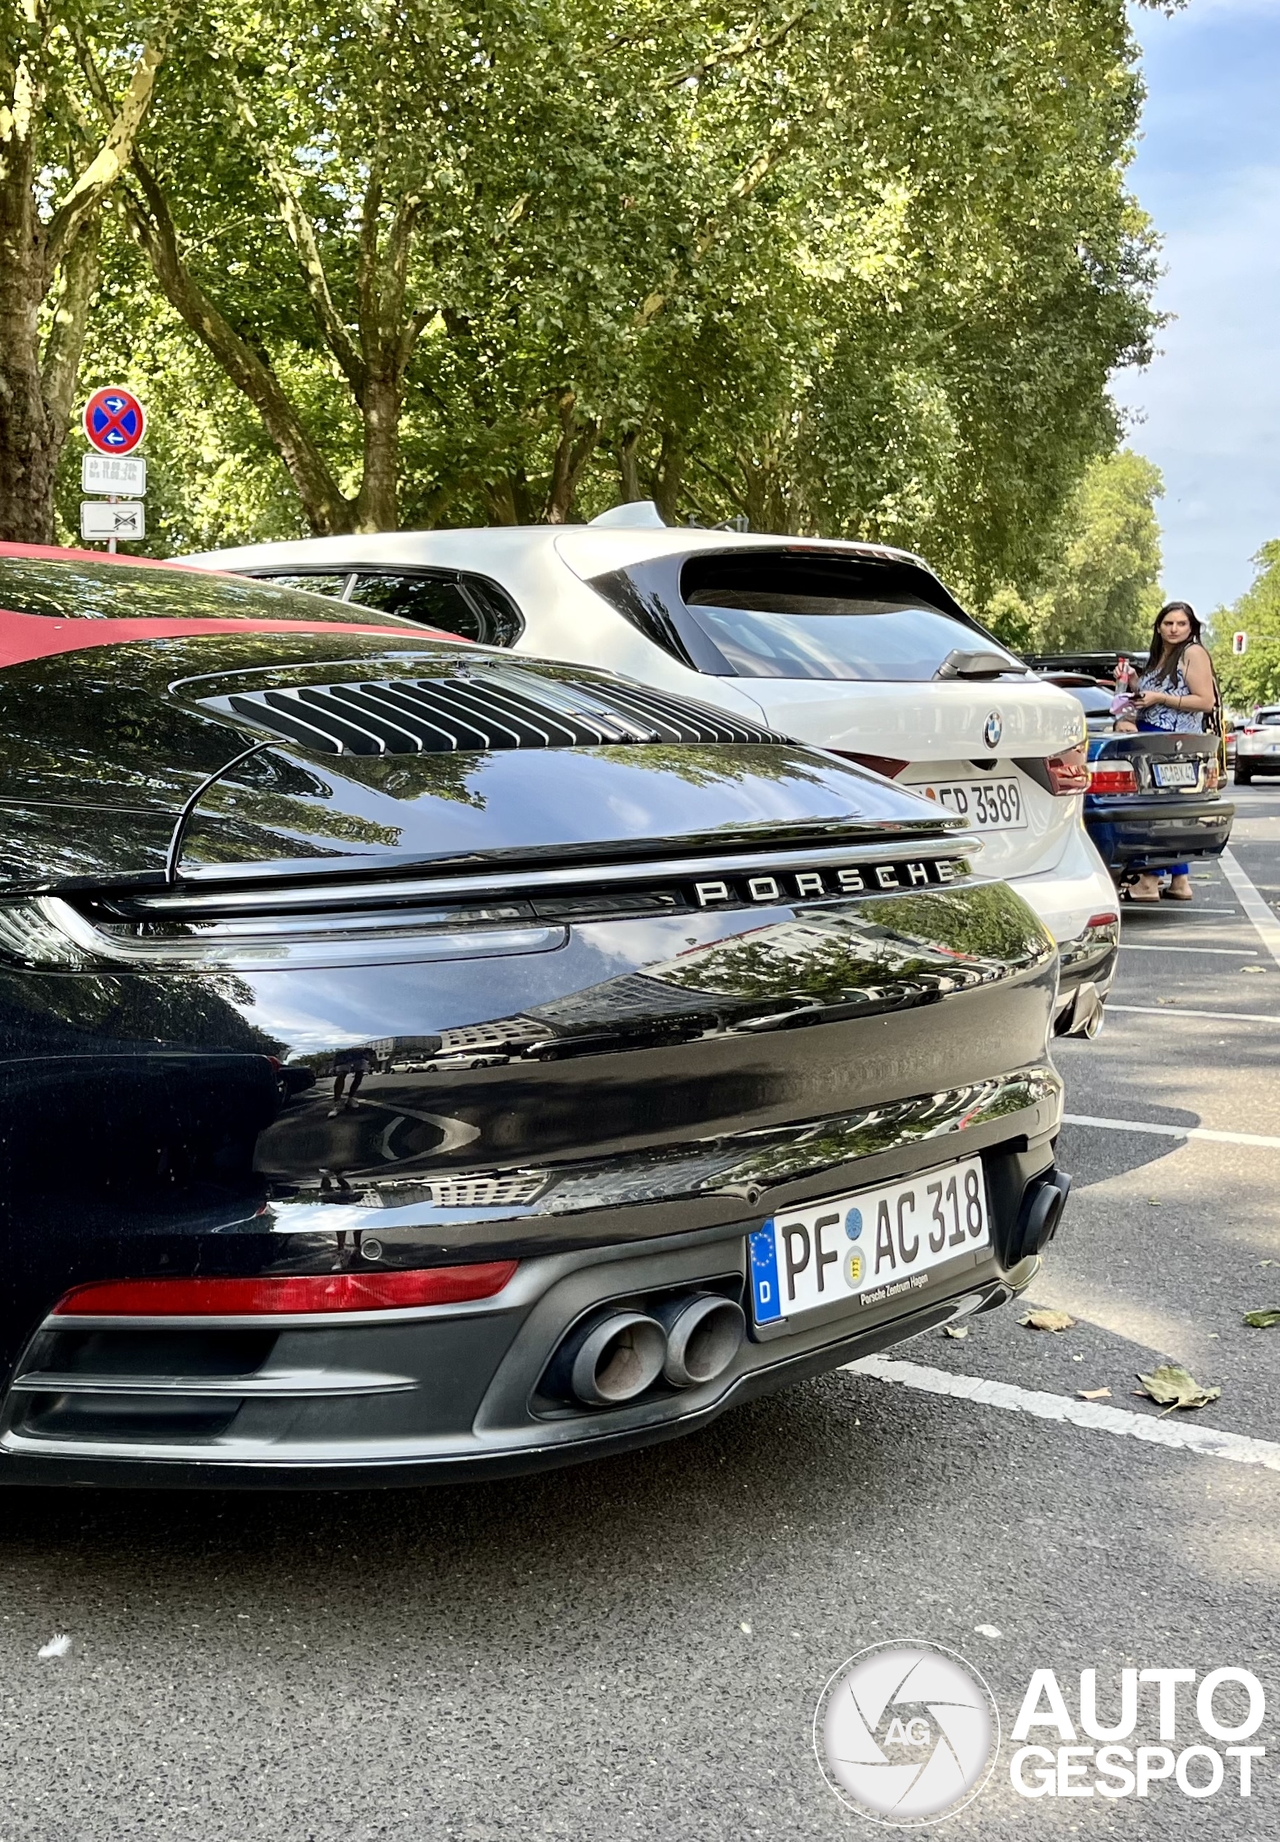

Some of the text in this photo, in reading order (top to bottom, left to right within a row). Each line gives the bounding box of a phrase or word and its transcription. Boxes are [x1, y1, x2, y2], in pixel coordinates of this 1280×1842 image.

[971, 784, 1020, 824] 3589
[695, 860, 956, 906] PORSCHE
[782, 1168, 983, 1301] PF AC 318
[758, 1280, 771, 1303] D
[860, 1273, 929, 1306] Porsche Zentrum Hagen
